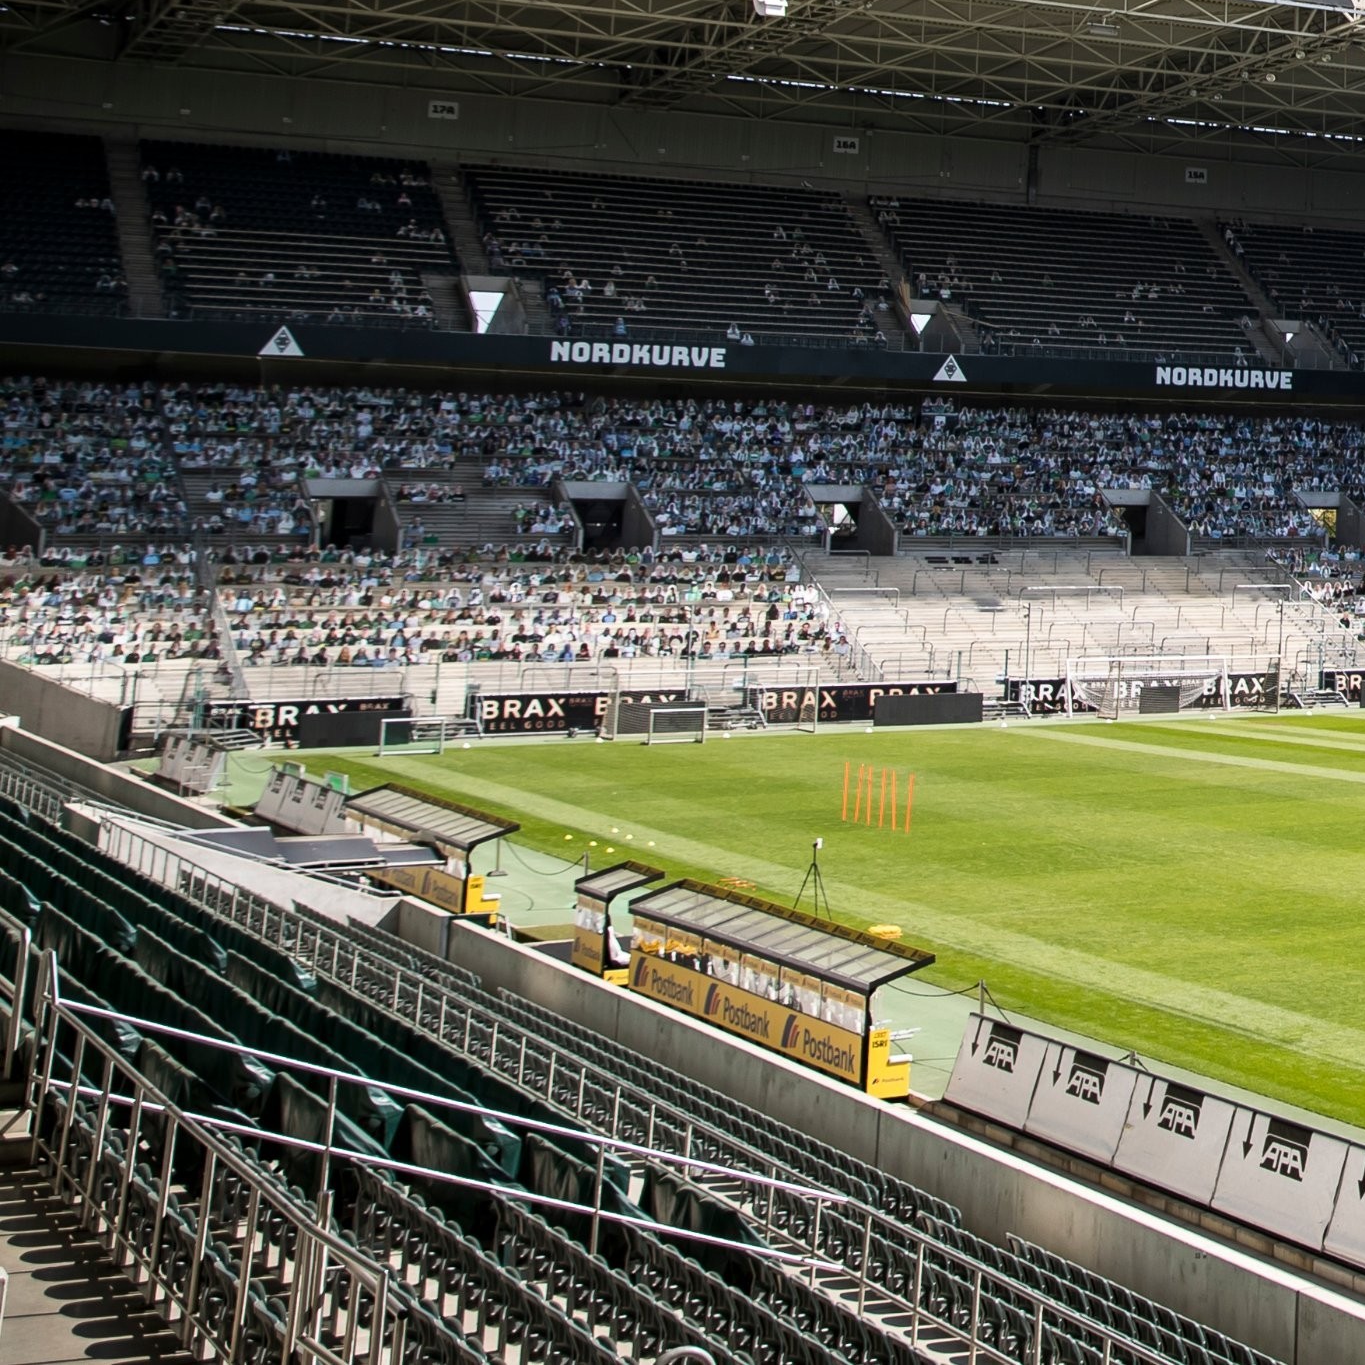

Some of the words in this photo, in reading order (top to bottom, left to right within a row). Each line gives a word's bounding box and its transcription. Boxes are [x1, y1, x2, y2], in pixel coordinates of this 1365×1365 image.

[431, 104, 456, 115] 17A
[836, 140, 857, 150] 16A
[1187, 171, 1205, 180] 15A
[550, 340, 727, 369] NORDKURVE
[1155, 365, 1294, 390] NORDKURVE
[482, 698, 565, 720] BRAX
[764, 690, 838, 710] BRAX
[489, 721, 517, 731] EEL
[524, 719, 566, 730] GOOD
[651, 968, 694, 1008] Postbank
[722, 996, 771, 1040] Postbank
[802, 1028, 856, 1076] Postbank
